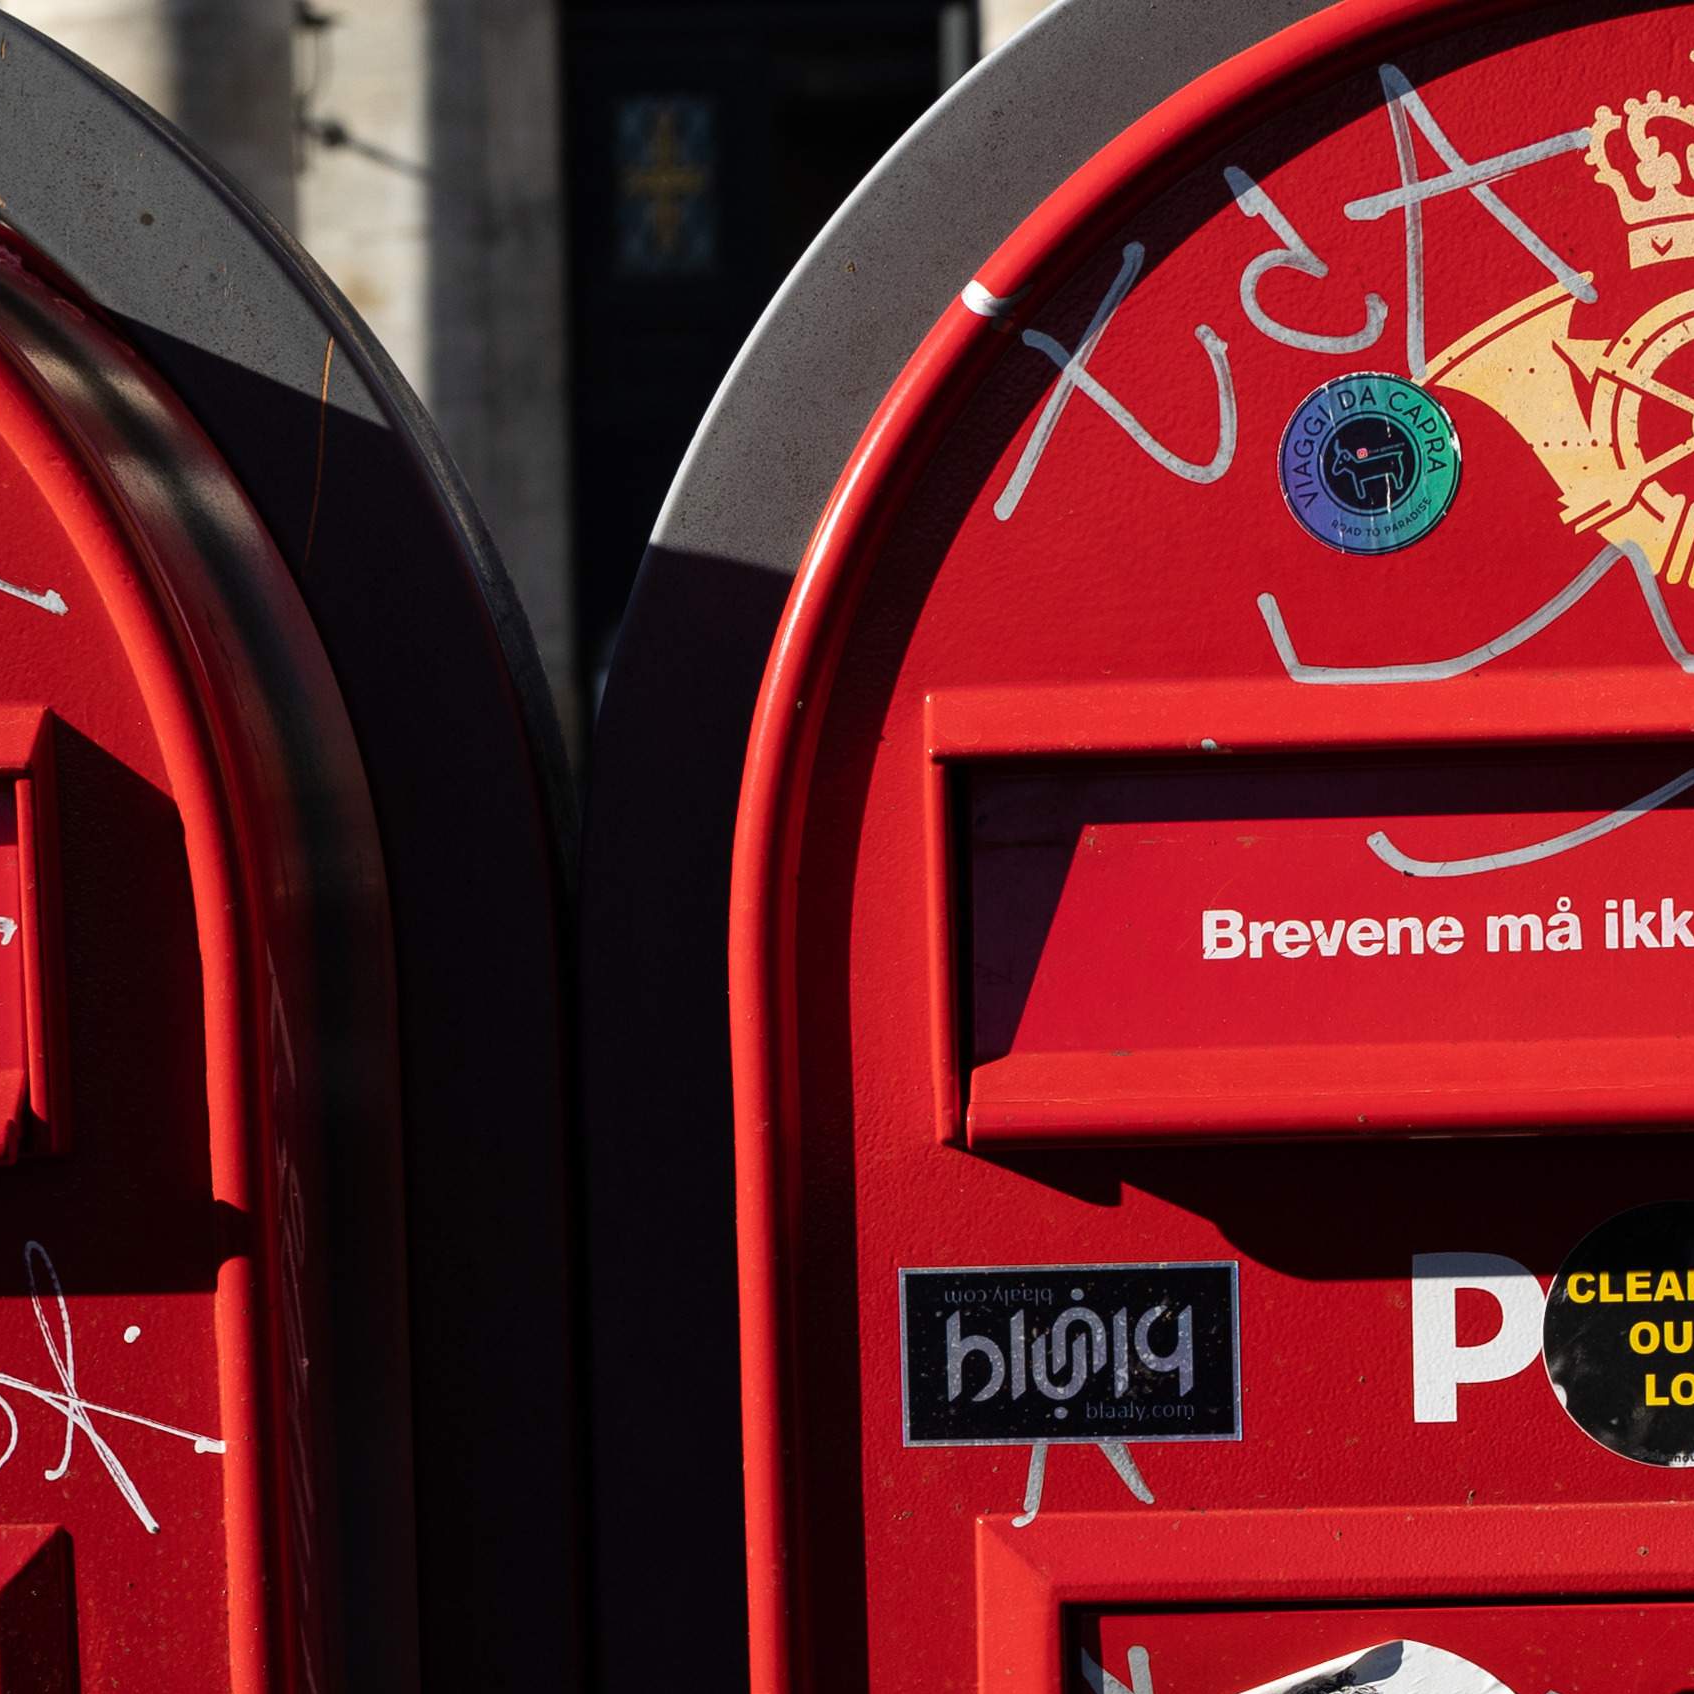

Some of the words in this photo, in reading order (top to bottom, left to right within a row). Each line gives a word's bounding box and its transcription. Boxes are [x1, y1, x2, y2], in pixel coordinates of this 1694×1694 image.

[1292, 404, 1332, 509] VIAGGI
[1337, 385, 1376, 410] DA
[1389, 391, 1447, 474] CAPRA
[1367, 528, 1380, 537] TO
[1385, 496, 1432, 534] PARADISE
[1201, 906, 1464, 960] Brevene
[1486, 896, 1582, 953] må
[944, 1287, 1053, 1305] blaaly.com
[1085, 1402, 1195, 1420] blaaly.com
